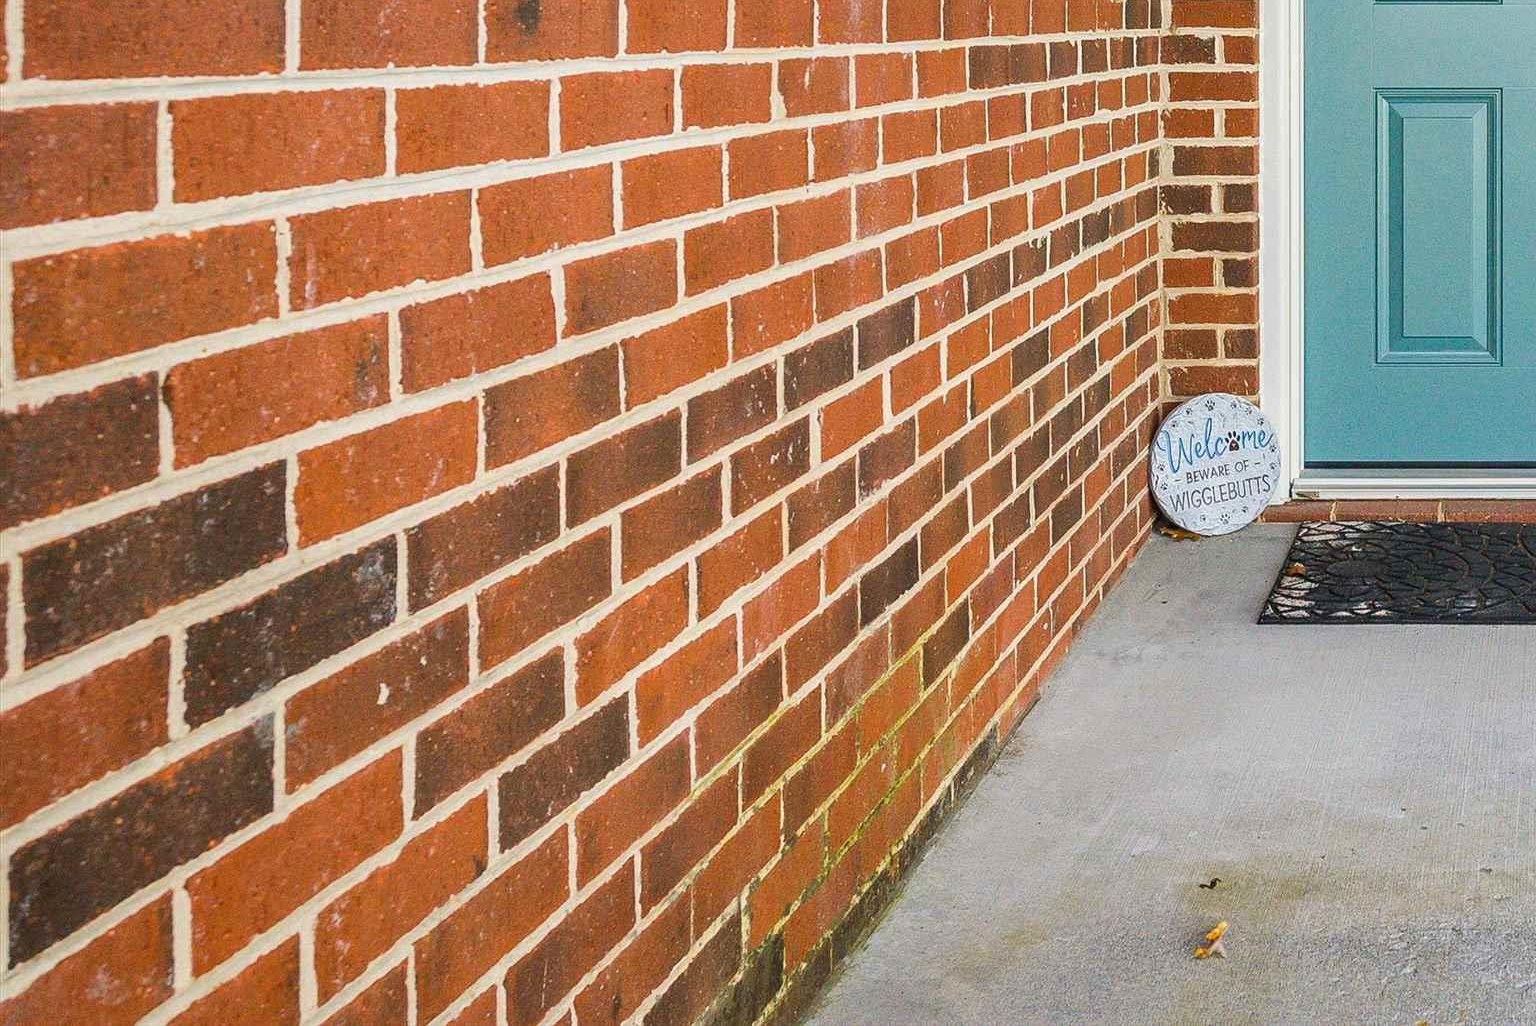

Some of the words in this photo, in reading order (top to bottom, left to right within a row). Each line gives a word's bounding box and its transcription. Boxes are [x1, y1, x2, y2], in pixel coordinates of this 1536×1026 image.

[1186, 463, 1230, 484] BEWARE
[1234, 459, 1249, 473] OF
[1169, 474, 1271, 512] WIGGLEBUTTS
